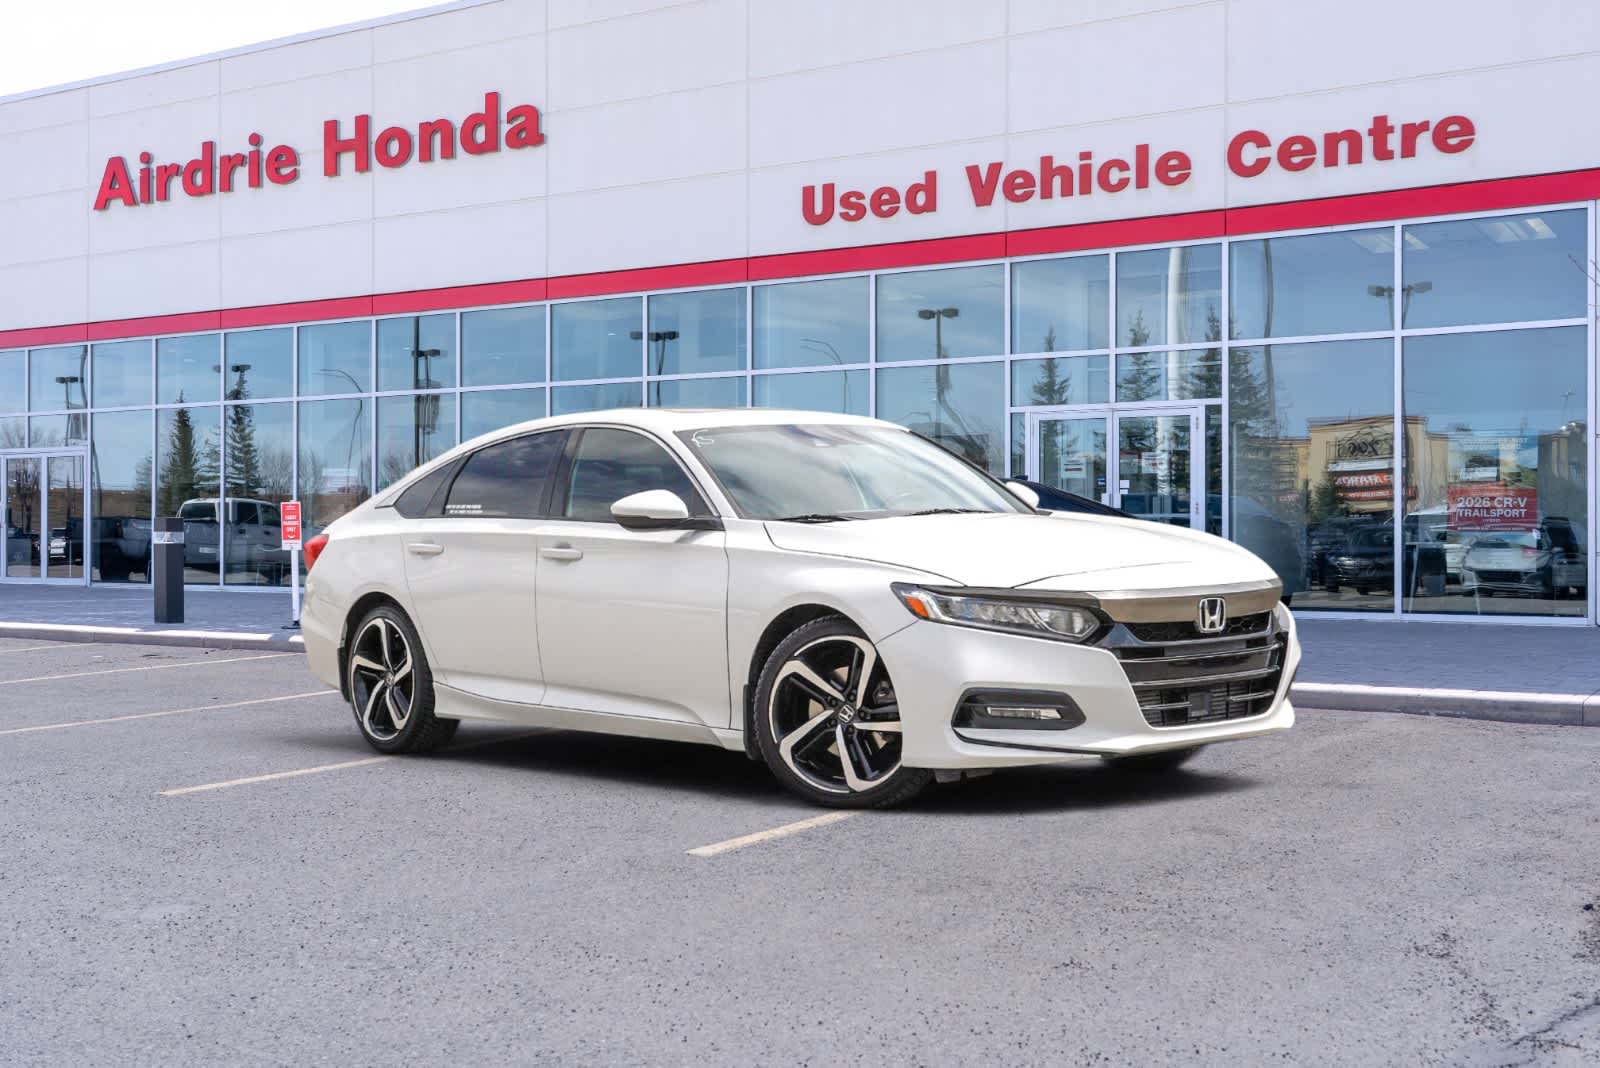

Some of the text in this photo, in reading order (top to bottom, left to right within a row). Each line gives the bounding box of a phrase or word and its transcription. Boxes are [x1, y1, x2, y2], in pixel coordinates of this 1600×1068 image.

[94, 91, 546, 210] Airdrie Honda
[802, 115, 1476, 225] Used Vehicle Centre
[1457, 496, 1528, 508] 2026 CR-V
[1457, 508, 1528, 518] TRAILSPORT
